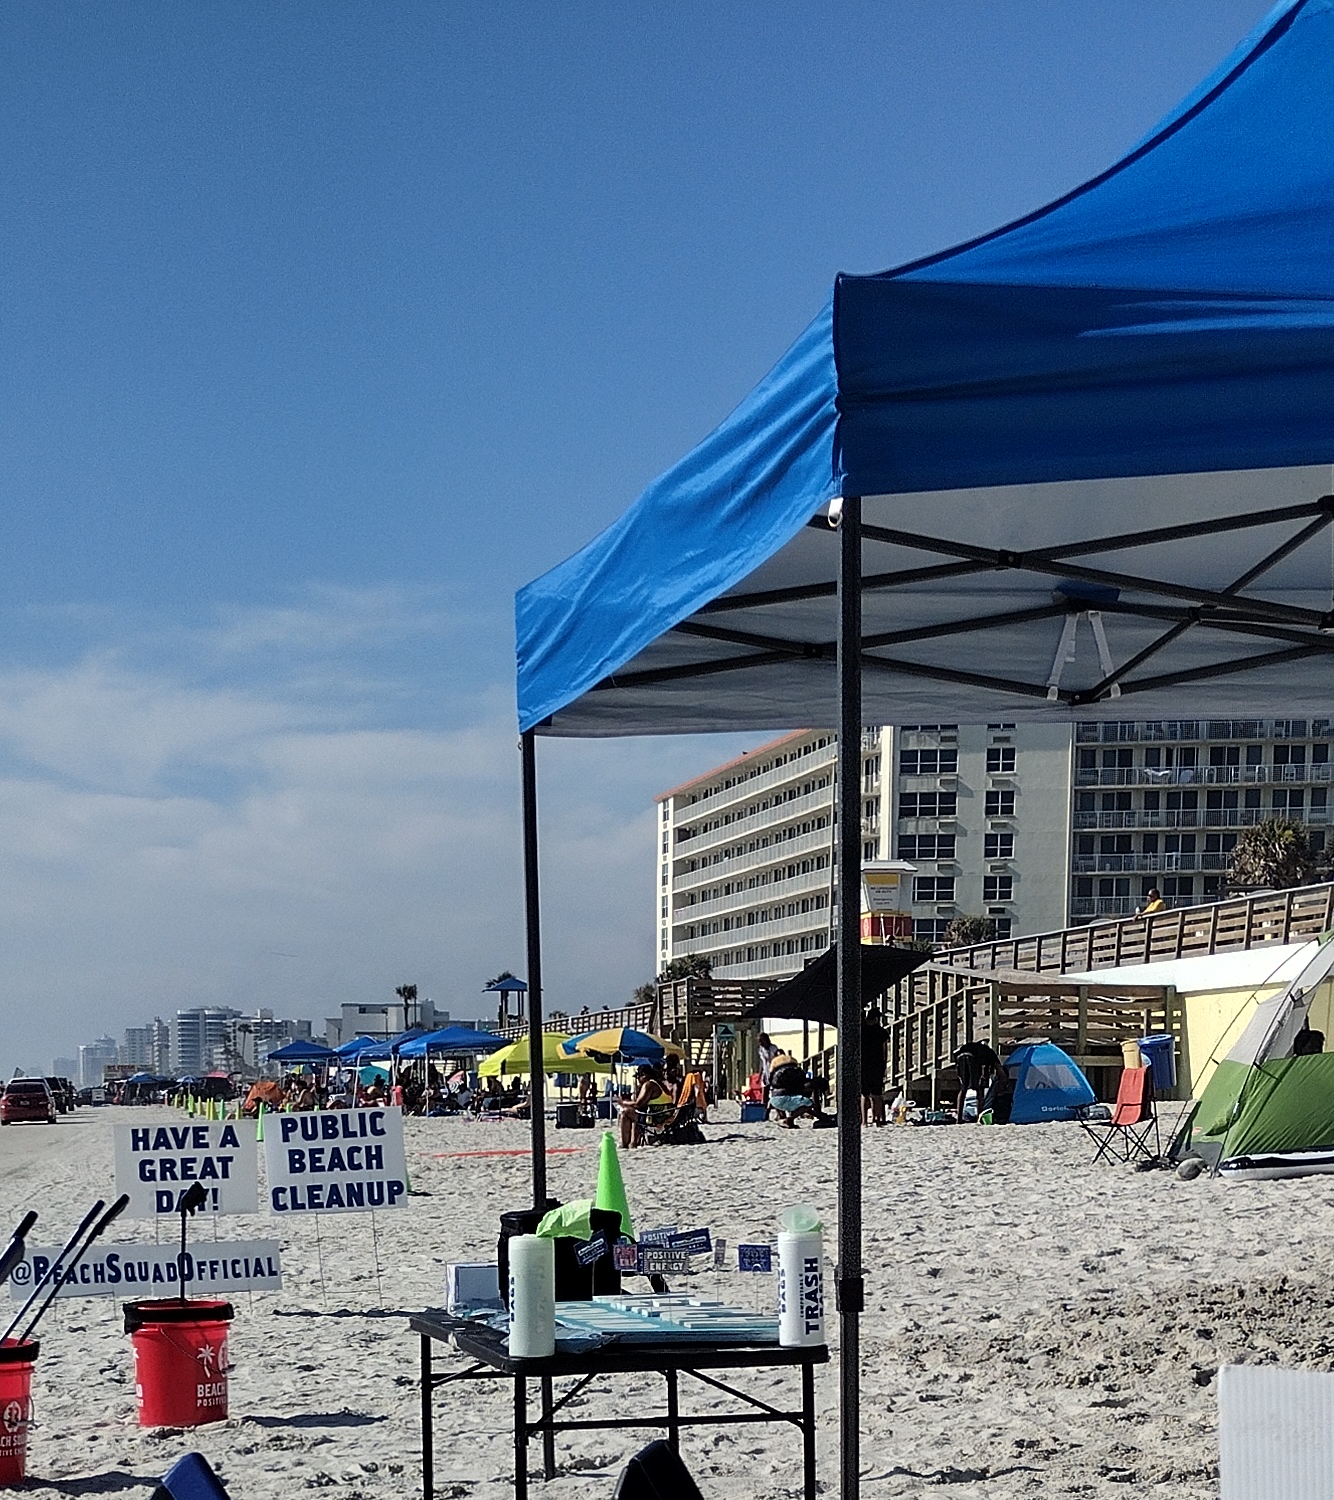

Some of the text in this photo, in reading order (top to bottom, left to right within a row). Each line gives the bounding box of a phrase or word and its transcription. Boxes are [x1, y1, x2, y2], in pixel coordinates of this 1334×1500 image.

[131, 1125, 240, 1152] HAVE A
[280, 1111, 386, 1143] PUBLIC
[138, 1156, 234, 1182] GREAT
[288, 1145, 384, 1174] BEACH
[272, 1180, 405, 1211] CLEANUP
[647, 1251, 687, 1260] POSITIVE
[649, 1262, 684, 1271] ENERGY
[804, 1257, 819, 1335] TRASH
